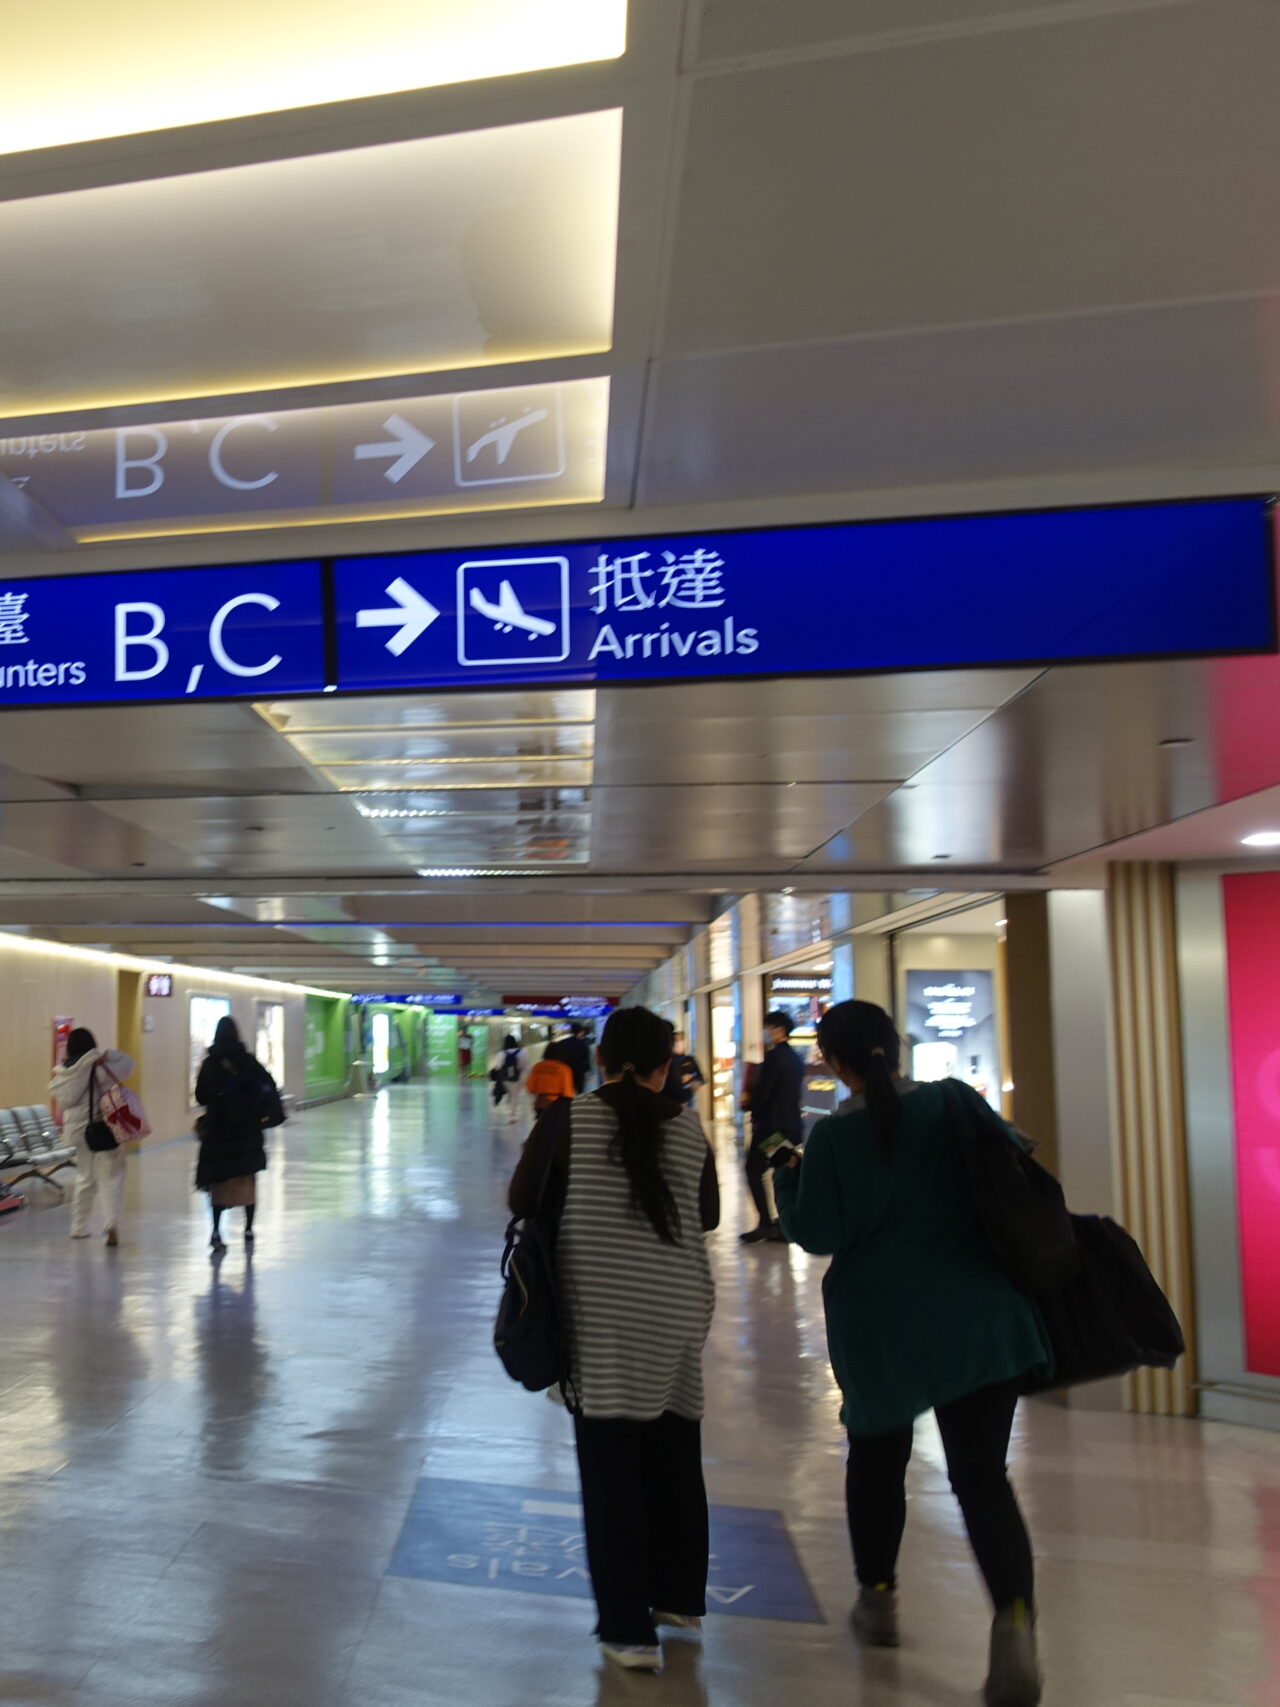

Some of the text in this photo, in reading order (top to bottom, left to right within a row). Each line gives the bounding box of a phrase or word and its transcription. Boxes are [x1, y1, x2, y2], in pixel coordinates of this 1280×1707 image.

[587, 548, 726, 615] 抵達
[587, 616, 759, 661] Arrivals
[447, 1552, 755, 1604] Avals
